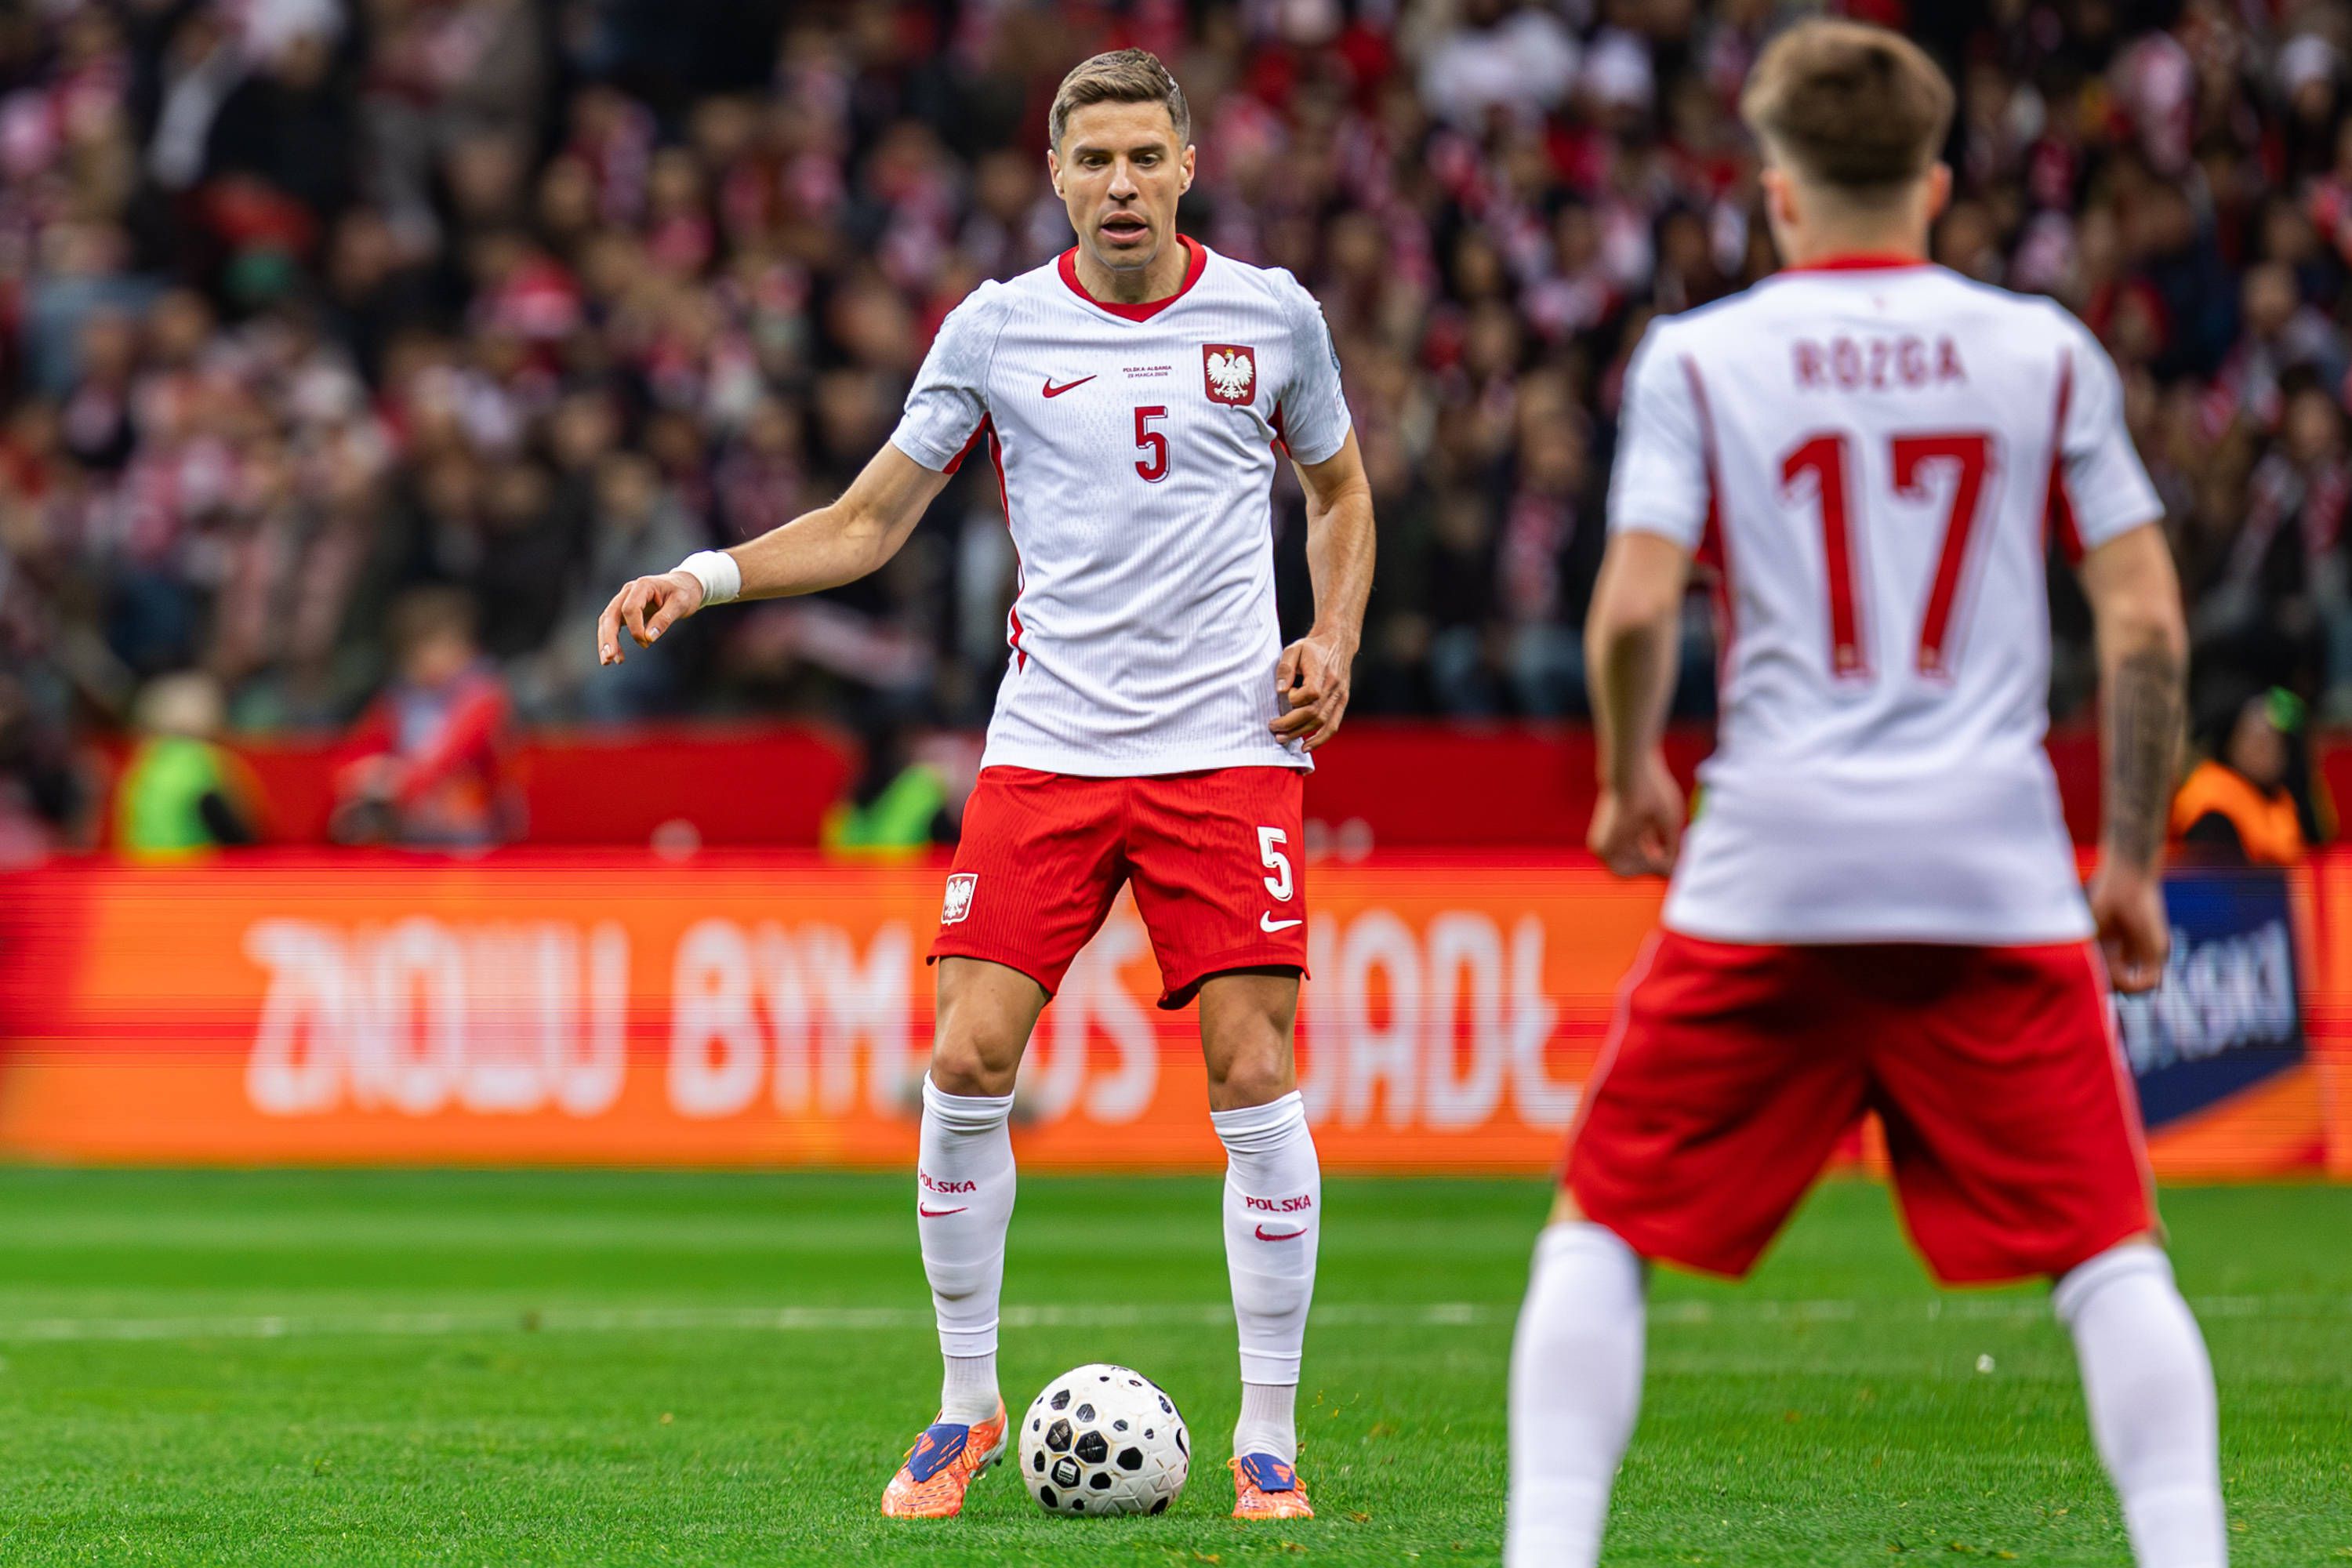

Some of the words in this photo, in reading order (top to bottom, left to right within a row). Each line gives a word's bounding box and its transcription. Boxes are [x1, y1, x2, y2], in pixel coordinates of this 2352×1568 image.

[1134, 405, 1170, 483] 5
[1778, 428, 1998, 684] 17
[1257, 826, 1294, 902] 5
[666, 918, 914, 1120] BYM
[1301, 906, 1585, 1134] JADŁ
[1246, 1194, 1312, 1213] POLSKA
